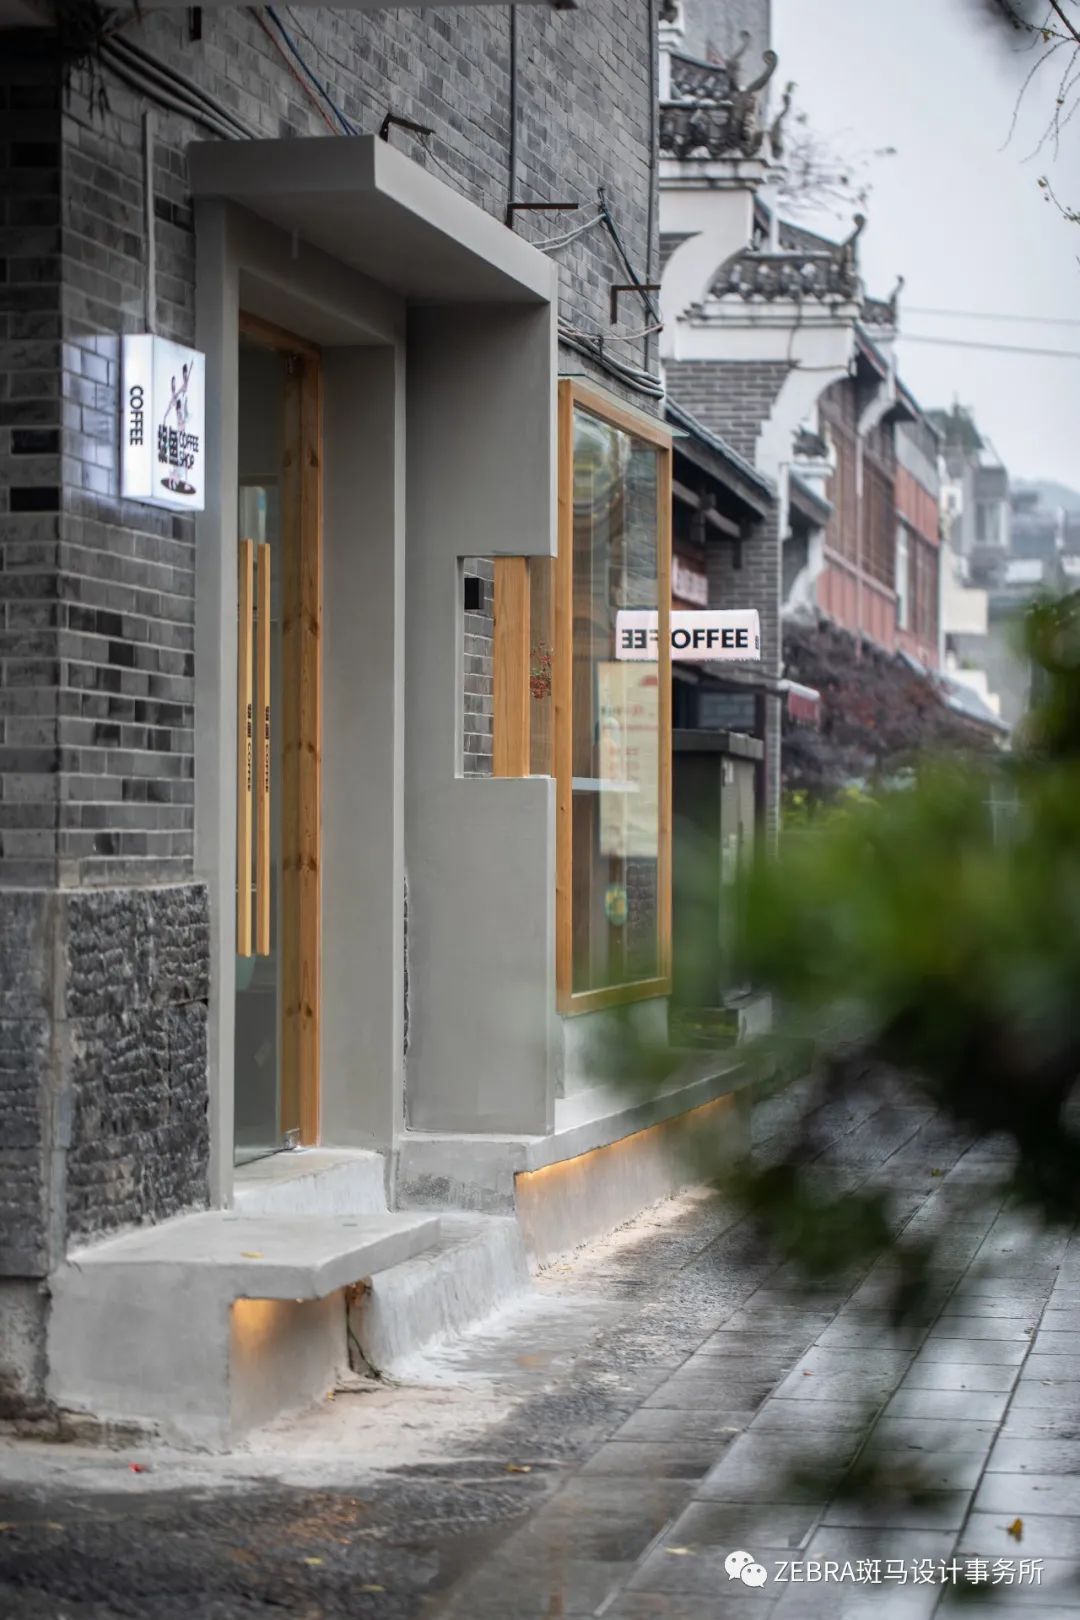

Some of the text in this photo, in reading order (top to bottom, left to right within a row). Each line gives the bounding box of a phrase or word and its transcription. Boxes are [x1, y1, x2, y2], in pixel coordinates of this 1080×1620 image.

[130, 385, 144, 446] COFFEE
[179, 430, 199, 453] COFFEE
[179, 450, 195, 469] SHOP
[671, 629, 749, 649] OFFEE
